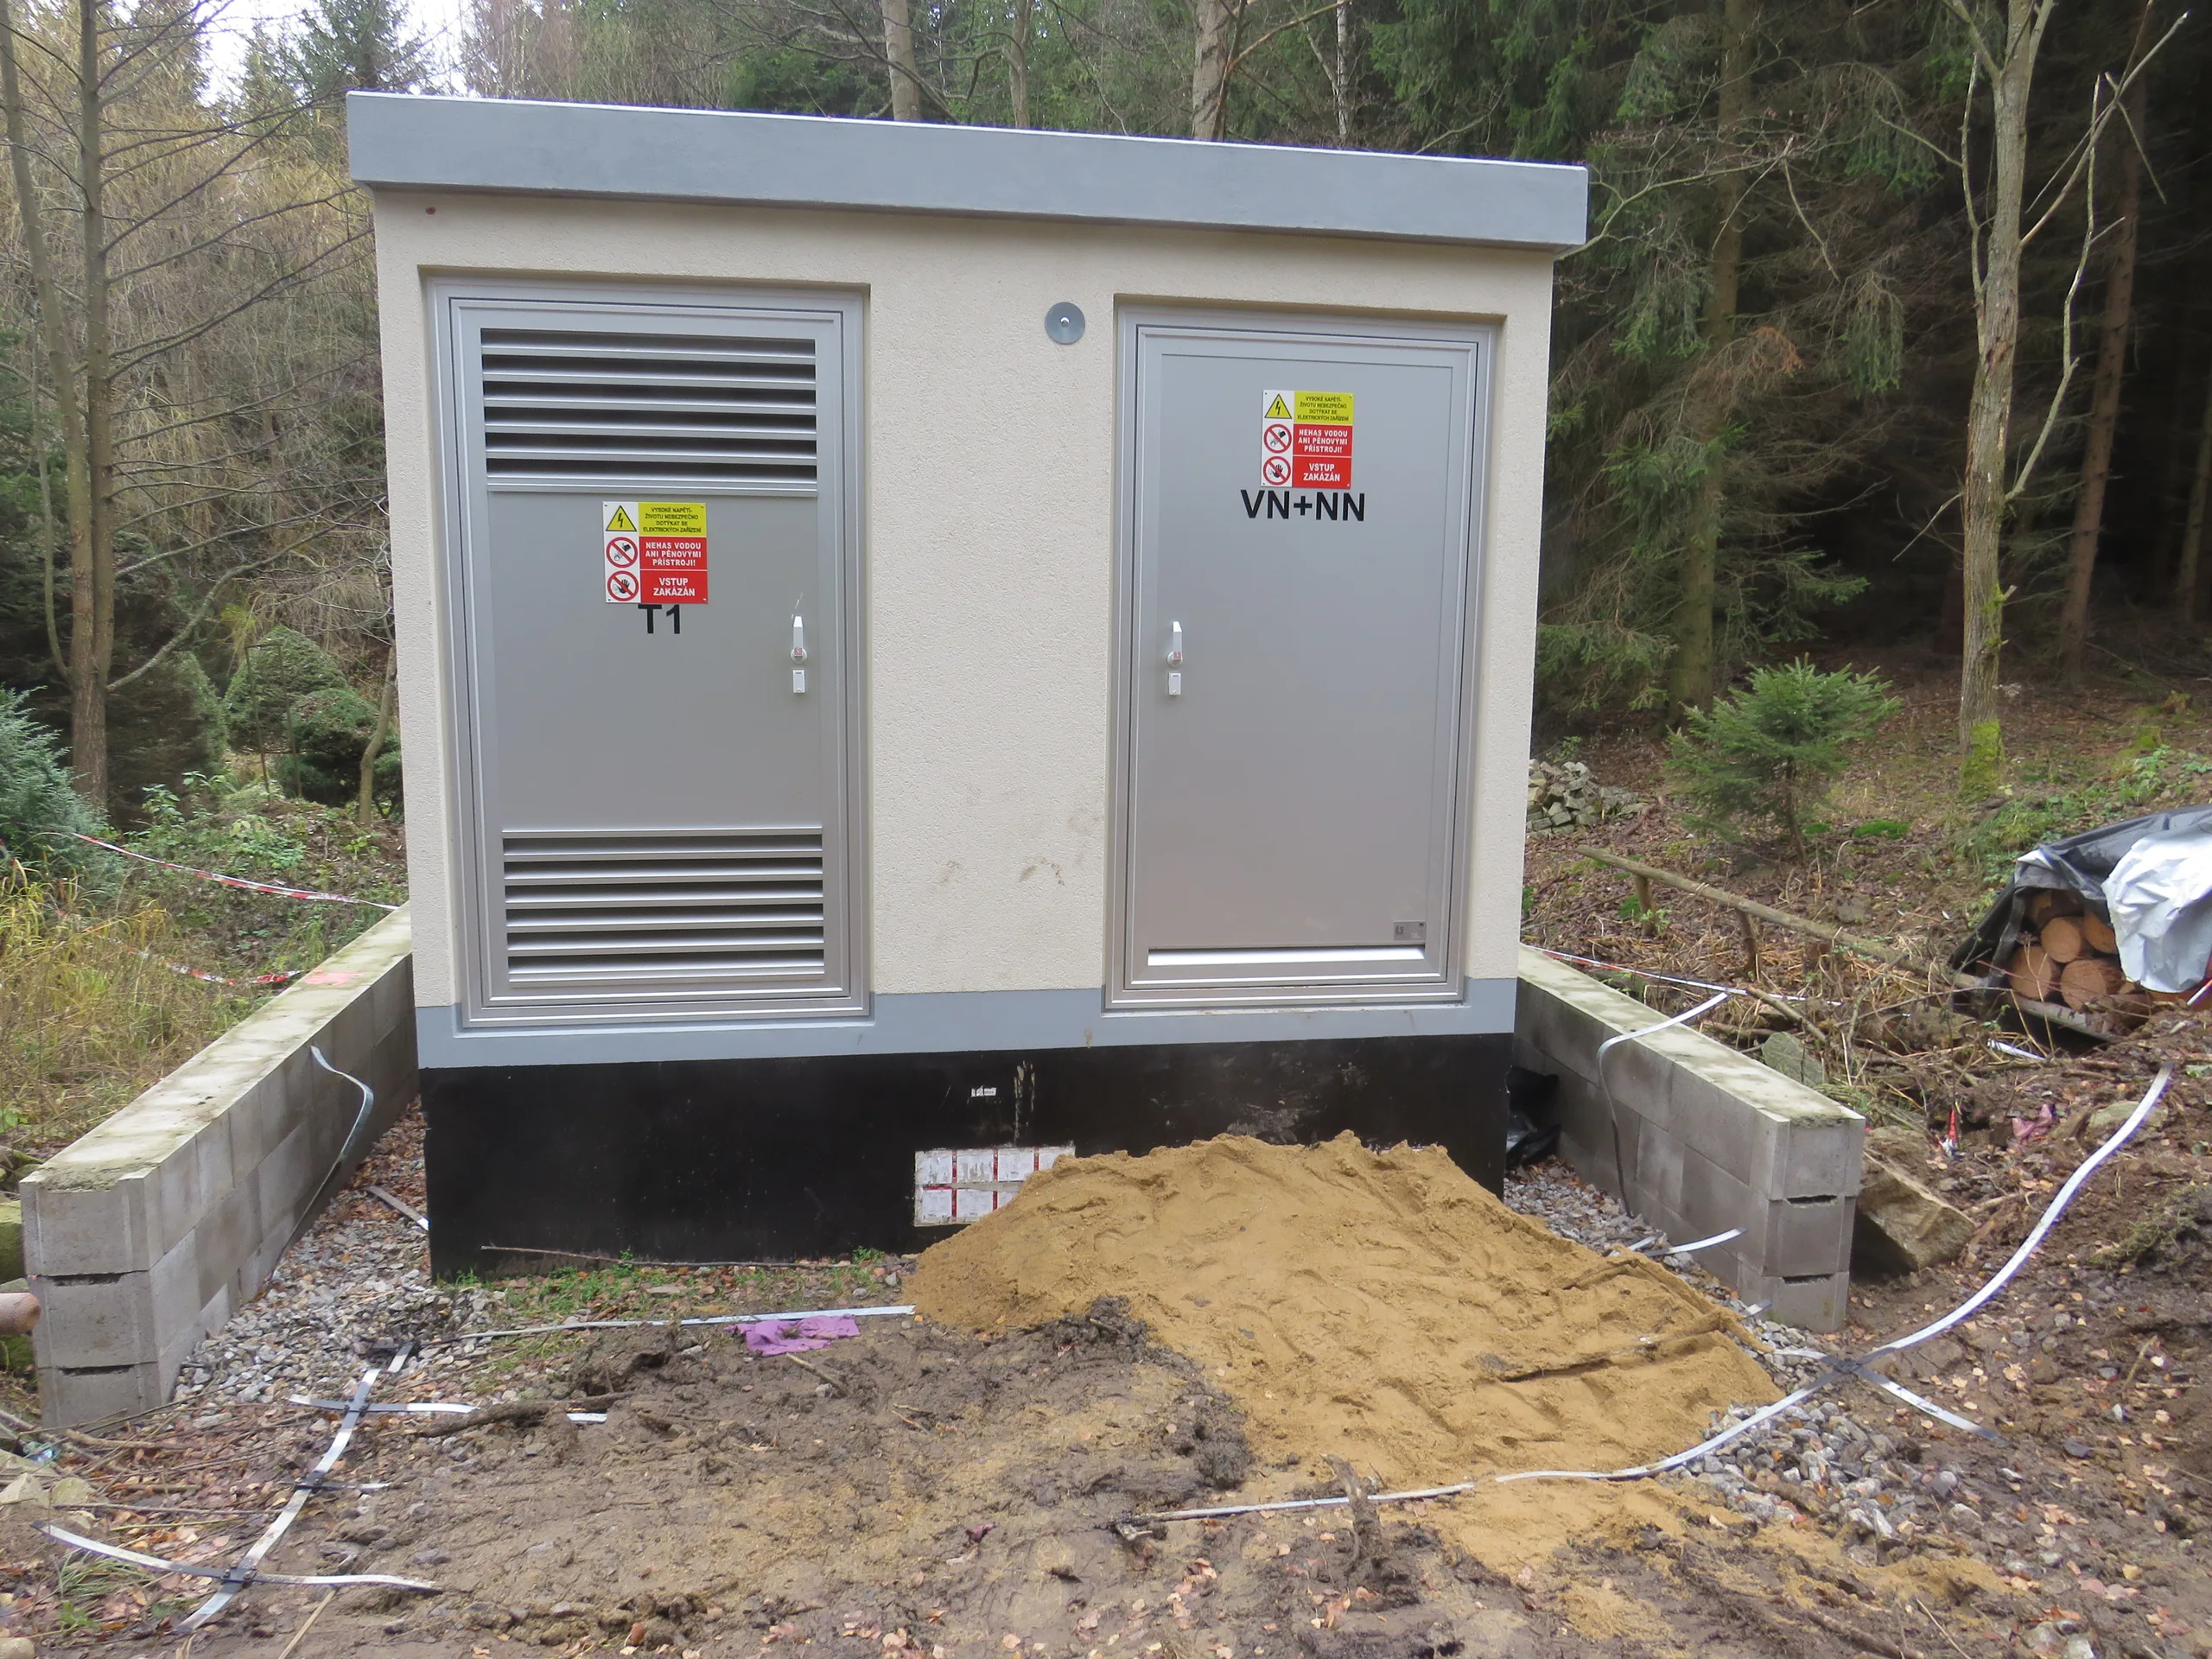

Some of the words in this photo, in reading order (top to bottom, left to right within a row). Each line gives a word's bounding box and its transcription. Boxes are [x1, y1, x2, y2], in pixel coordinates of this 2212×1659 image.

[1303, 473, 1340, 481] ZAKÁZÁN
[1241, 490, 1364, 522] VN+NN
[653, 588, 695, 596] ZAKÁZÁN
[639, 605, 680, 633] T1
